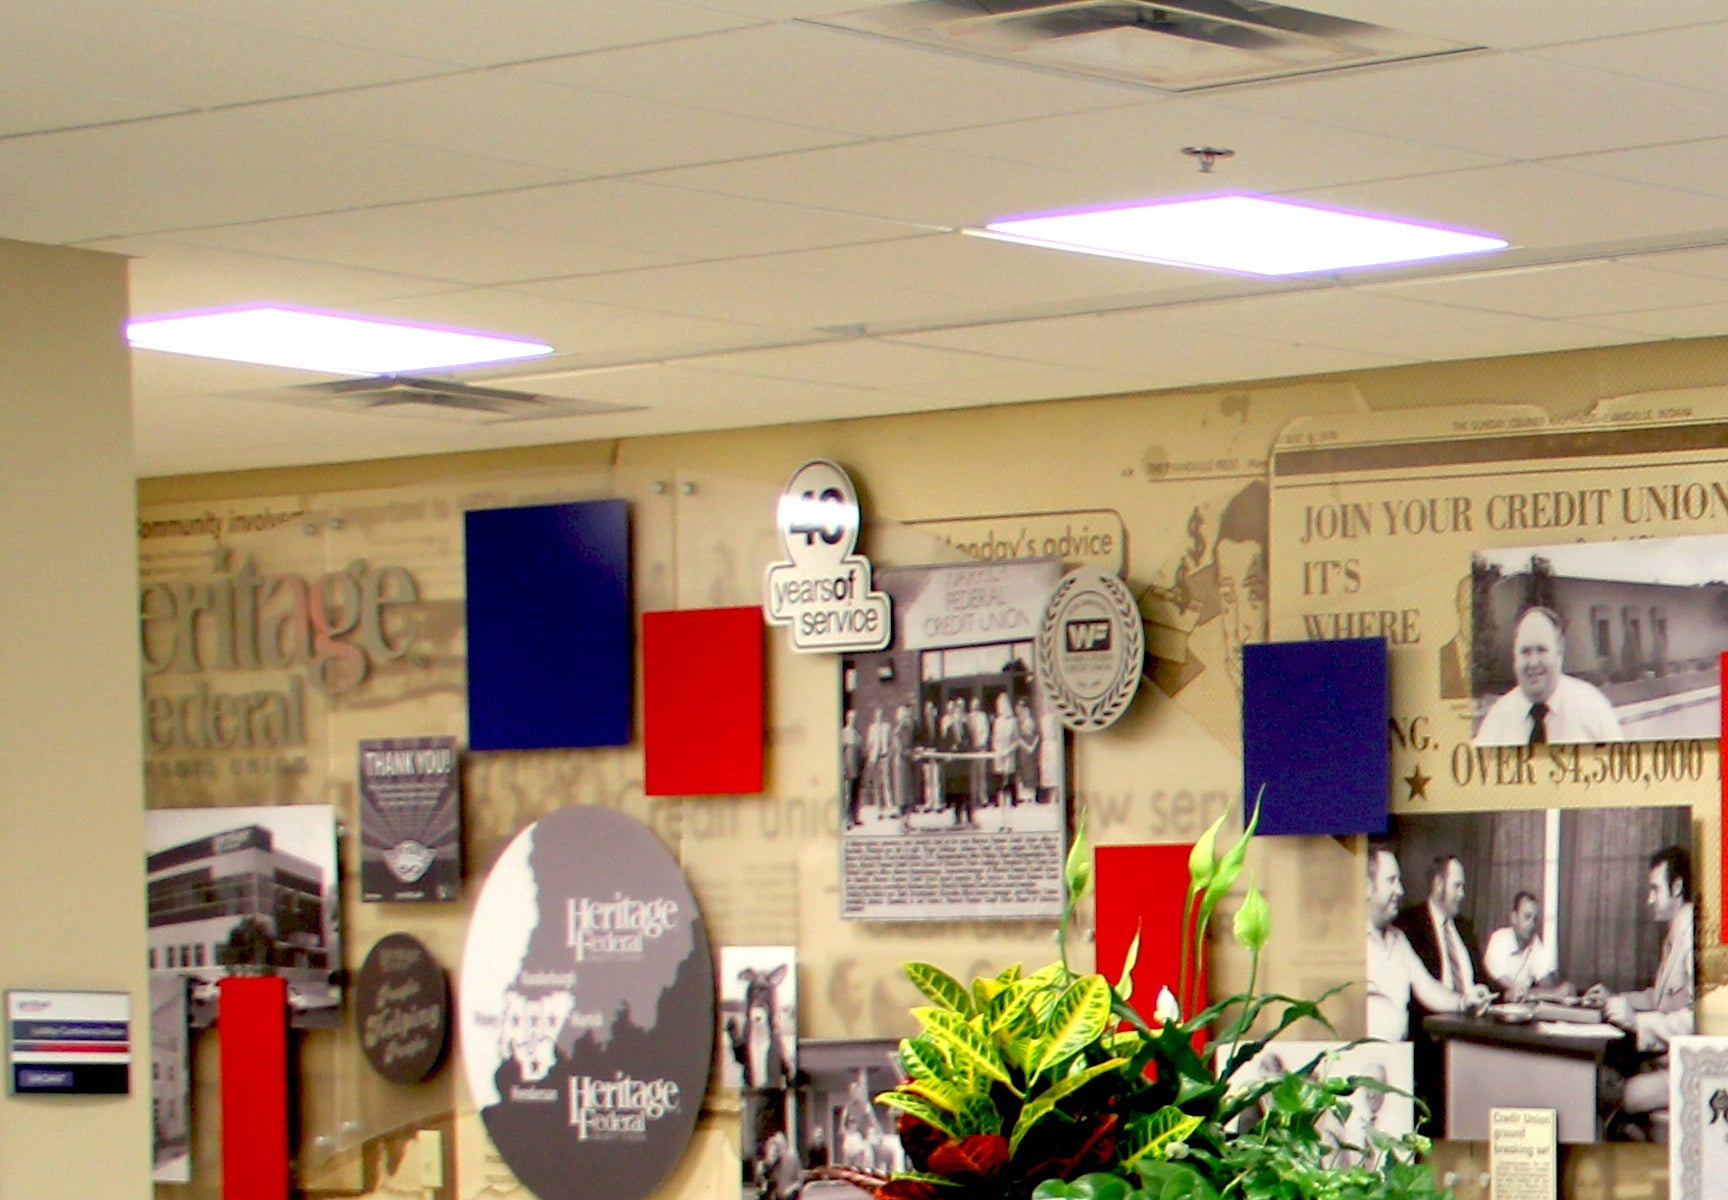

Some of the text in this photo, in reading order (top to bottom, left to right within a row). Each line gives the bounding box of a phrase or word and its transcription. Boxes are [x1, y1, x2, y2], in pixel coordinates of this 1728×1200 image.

[1300, 503, 1372, 544] JOIN
[1382, 496, 1474, 537] YOUR
[1486, 489, 1612, 530] CREDIT
[1044, 526, 1114, 559] advice
[1302, 558, 1361, 597] IT'S
[140, 546, 420, 699] eritage
[801, 605, 880, 635] service
[1066, 622, 1110, 651] WF
[1302, 608, 1422, 645] WHERE
[144, 674, 306, 750] ederal
[1451, 739, 1702, 791] OVER $4,500,000
[567, 890, 679, 949] Heritage
[574, 931, 644, 962] Federal
[567, 1070, 682, 1127] Heritage
[577, 1108, 648, 1142] Federal
